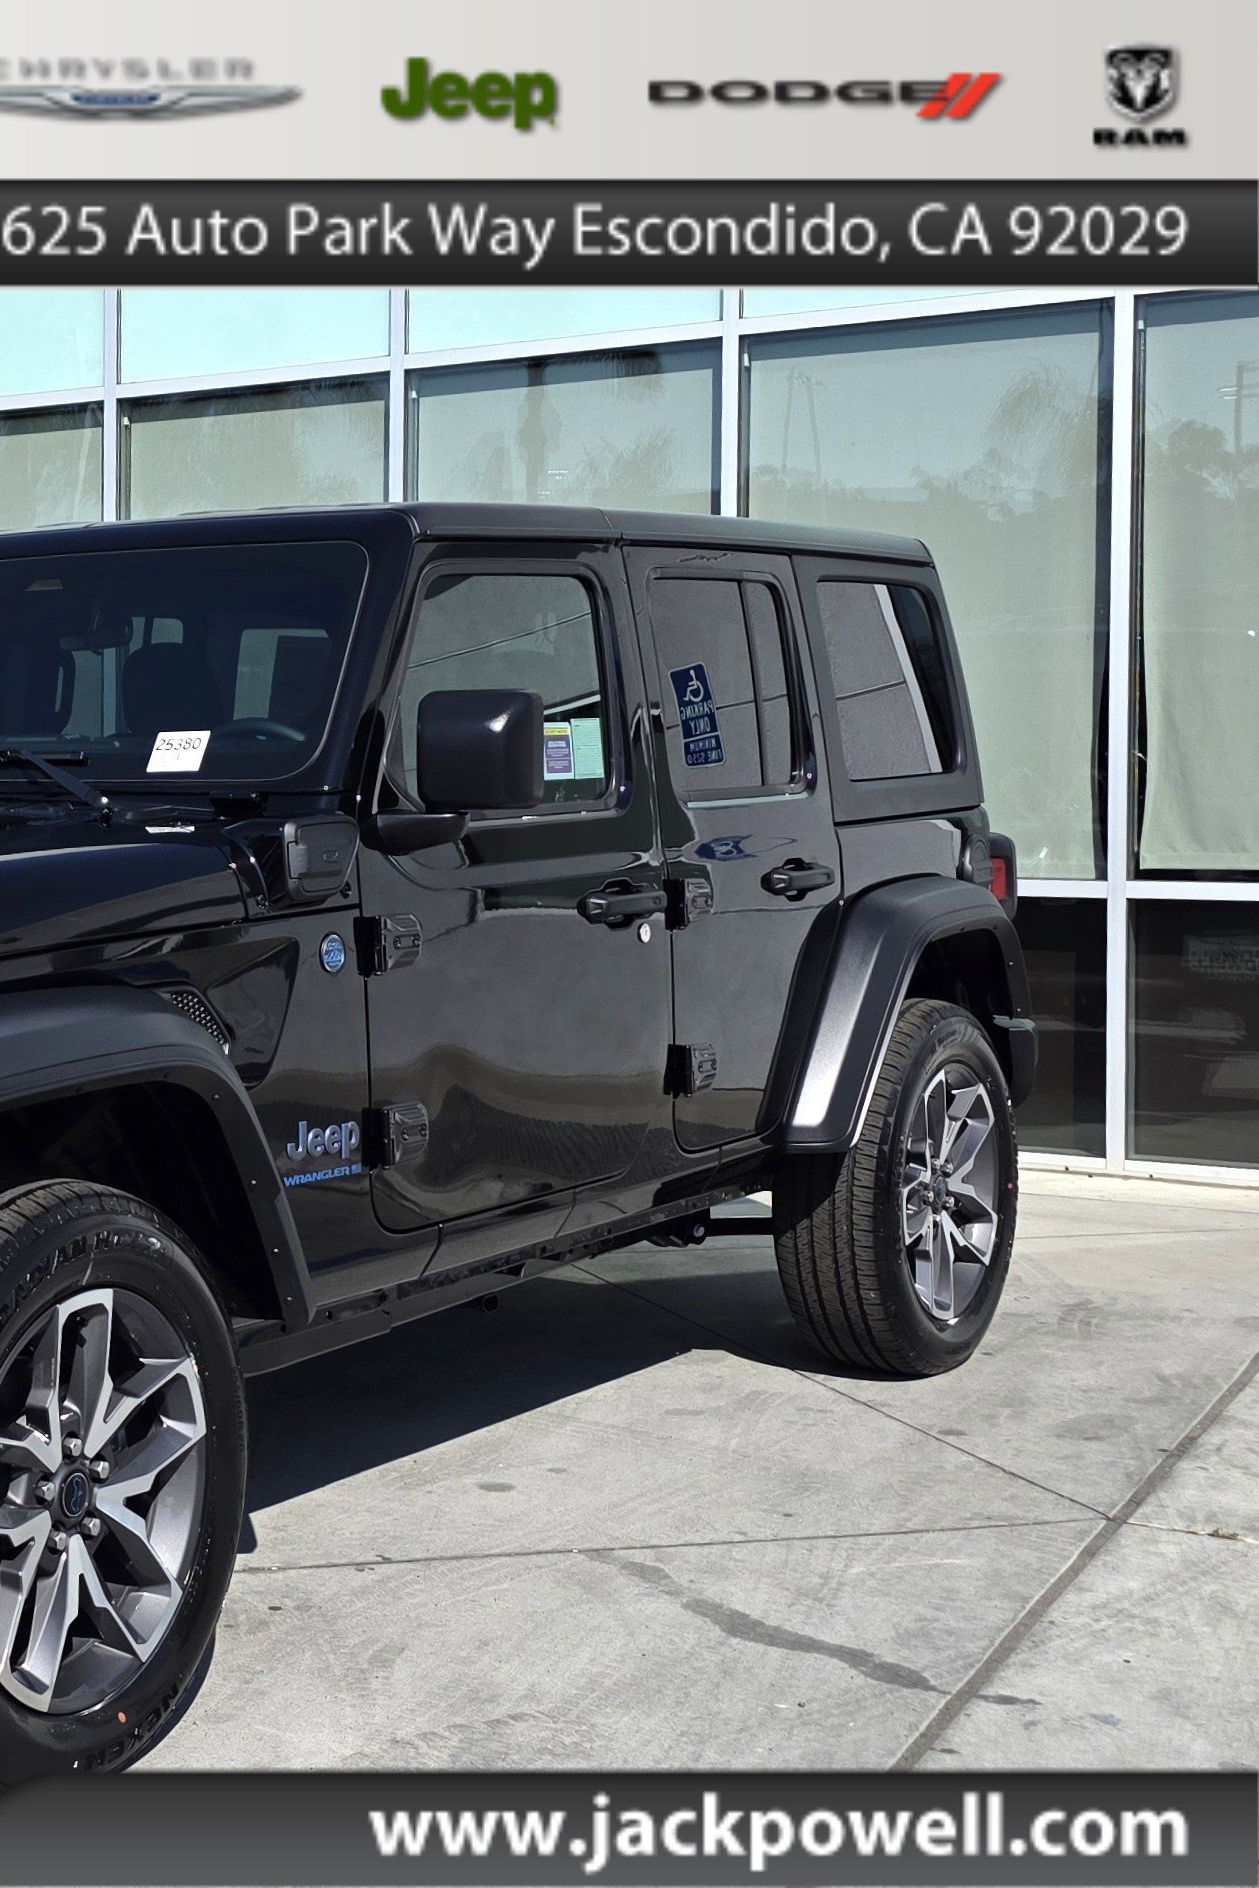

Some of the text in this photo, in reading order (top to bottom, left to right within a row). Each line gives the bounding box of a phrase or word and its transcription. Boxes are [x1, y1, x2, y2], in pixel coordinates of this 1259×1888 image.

[156, 737, 202, 751] 25380
[286, 1120, 360, 1160] Jeep
[283, 1167, 349, 1187] WRANGLER
